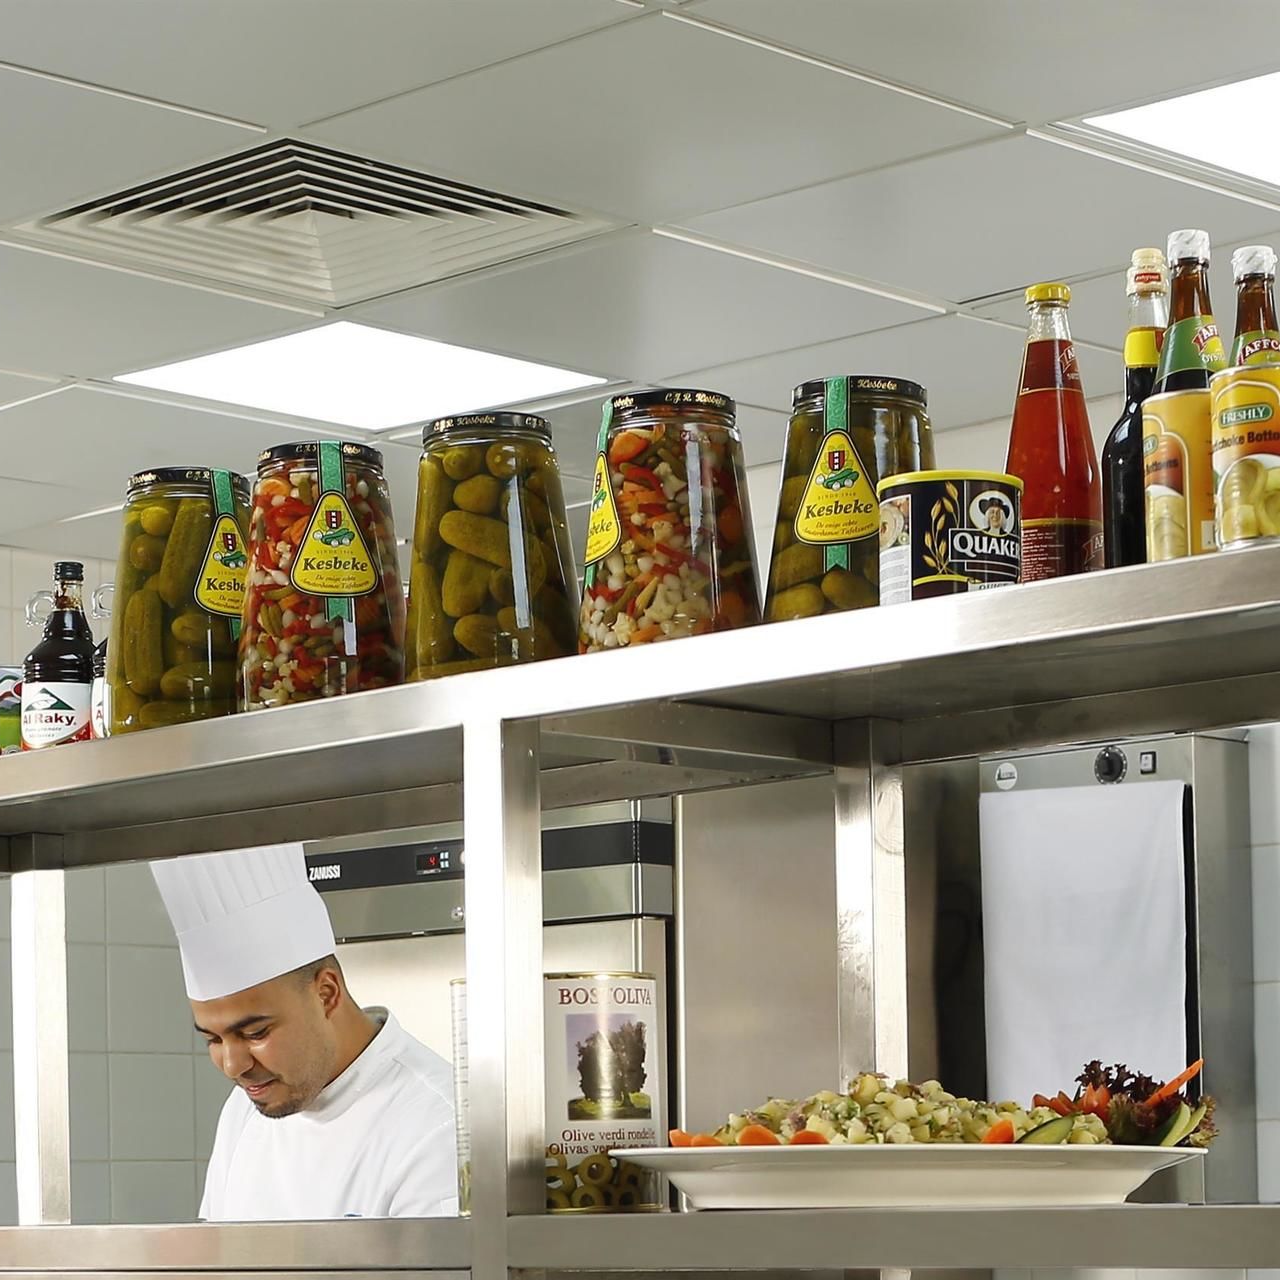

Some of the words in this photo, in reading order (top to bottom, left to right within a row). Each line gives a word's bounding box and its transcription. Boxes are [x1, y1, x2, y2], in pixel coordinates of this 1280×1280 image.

[857, 379, 897, 390] Kesbeke
[457, 415, 496, 426] Kesbeke
[1222, 408, 1266, 424] FRESHLY
[805, 500, 873, 520] Kesbeke
[303, 556, 368, 572] Kesbeke
[206, 577, 246, 591] Kesbe
[35, 713, 75, 726] Raky
[309, 865, 341, 881] ZANUSSI
[558, 986, 652, 1006] BOSOLIVA
[562, 1128, 595, 1142] Olive
[599, 1128, 625, 1141] verdi
[549, 1142, 589, 1156] Olivas
